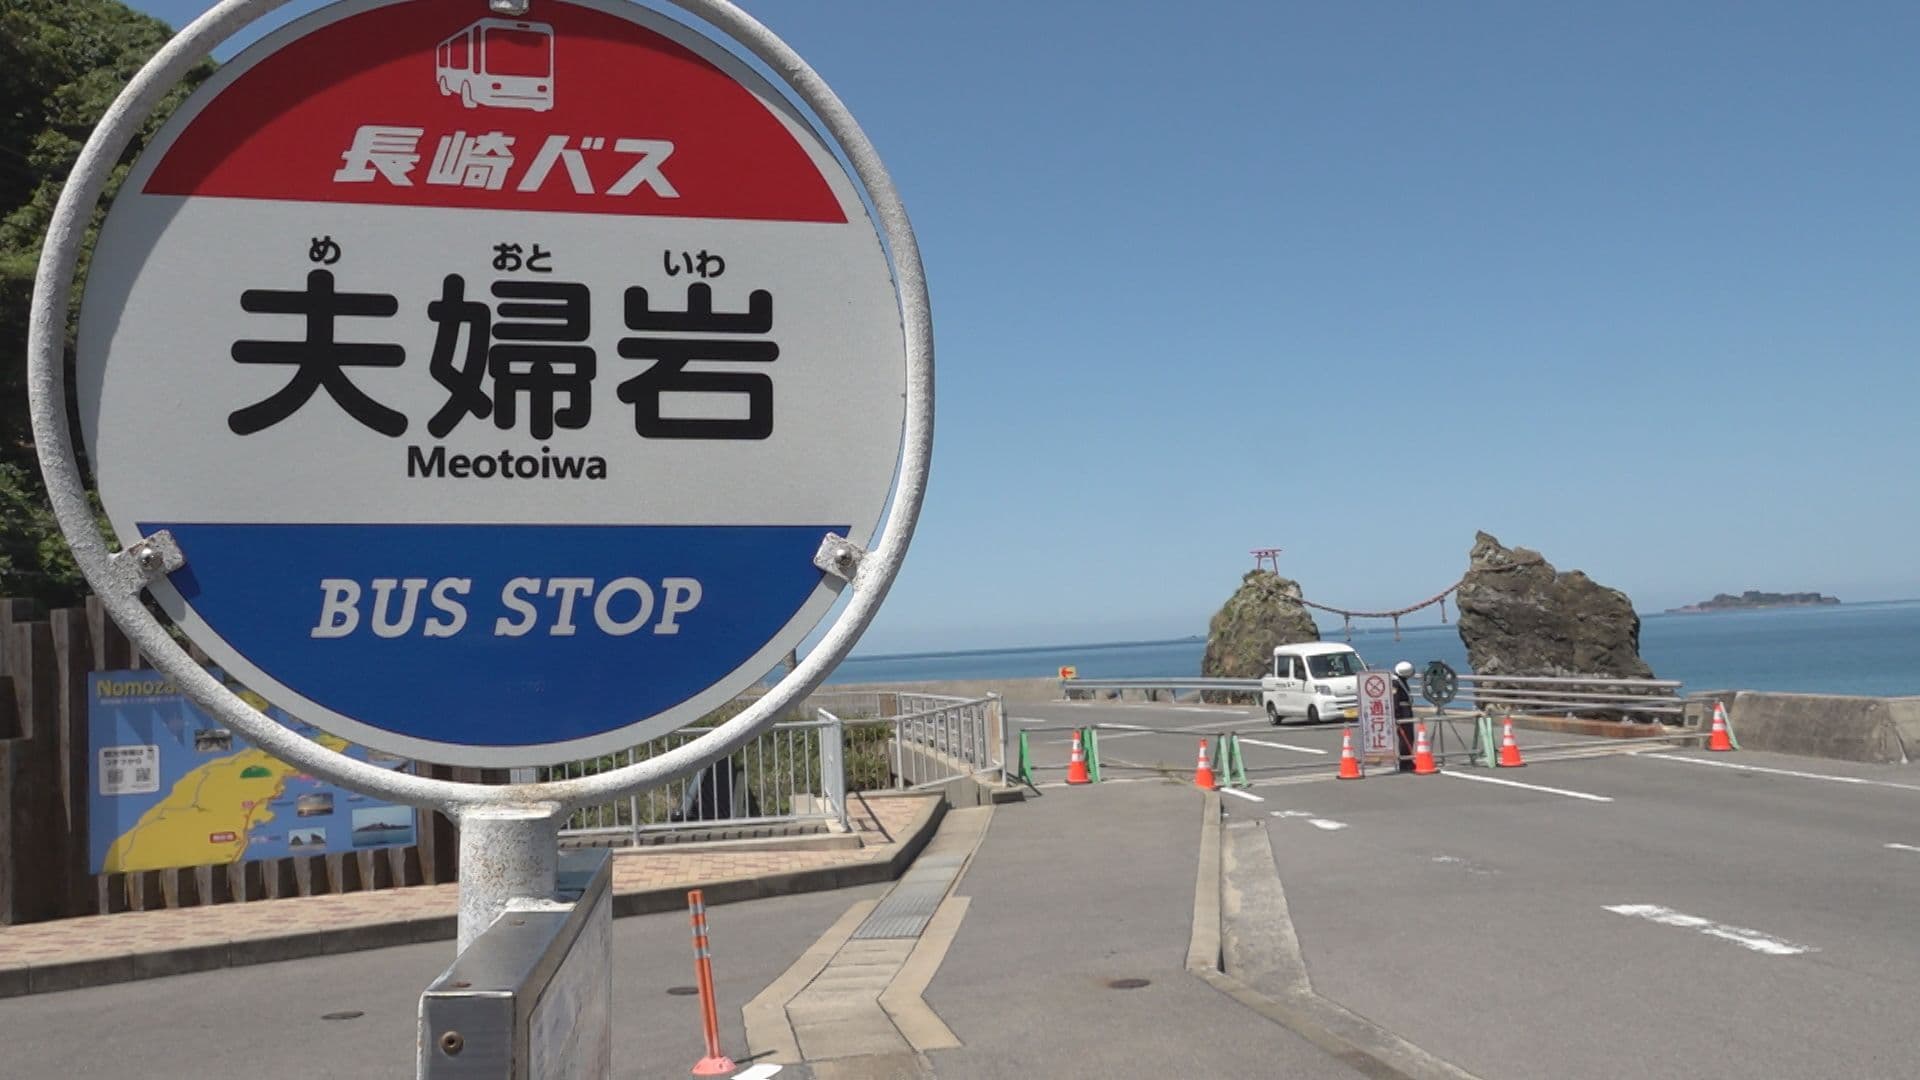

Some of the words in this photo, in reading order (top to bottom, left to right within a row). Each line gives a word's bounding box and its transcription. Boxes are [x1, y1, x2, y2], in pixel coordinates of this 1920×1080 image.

[333, 125, 681, 198] 長崎バス
[309, 236, 341, 265] め
[493, 243, 552, 272] おと
[664, 250, 725, 278] いわ
[228, 268, 779, 440] 夫婦岩
[408, 446, 606, 479] Meotoiwa
[311, 578, 471, 637] BUS
[495, 577, 702, 636] STOP
